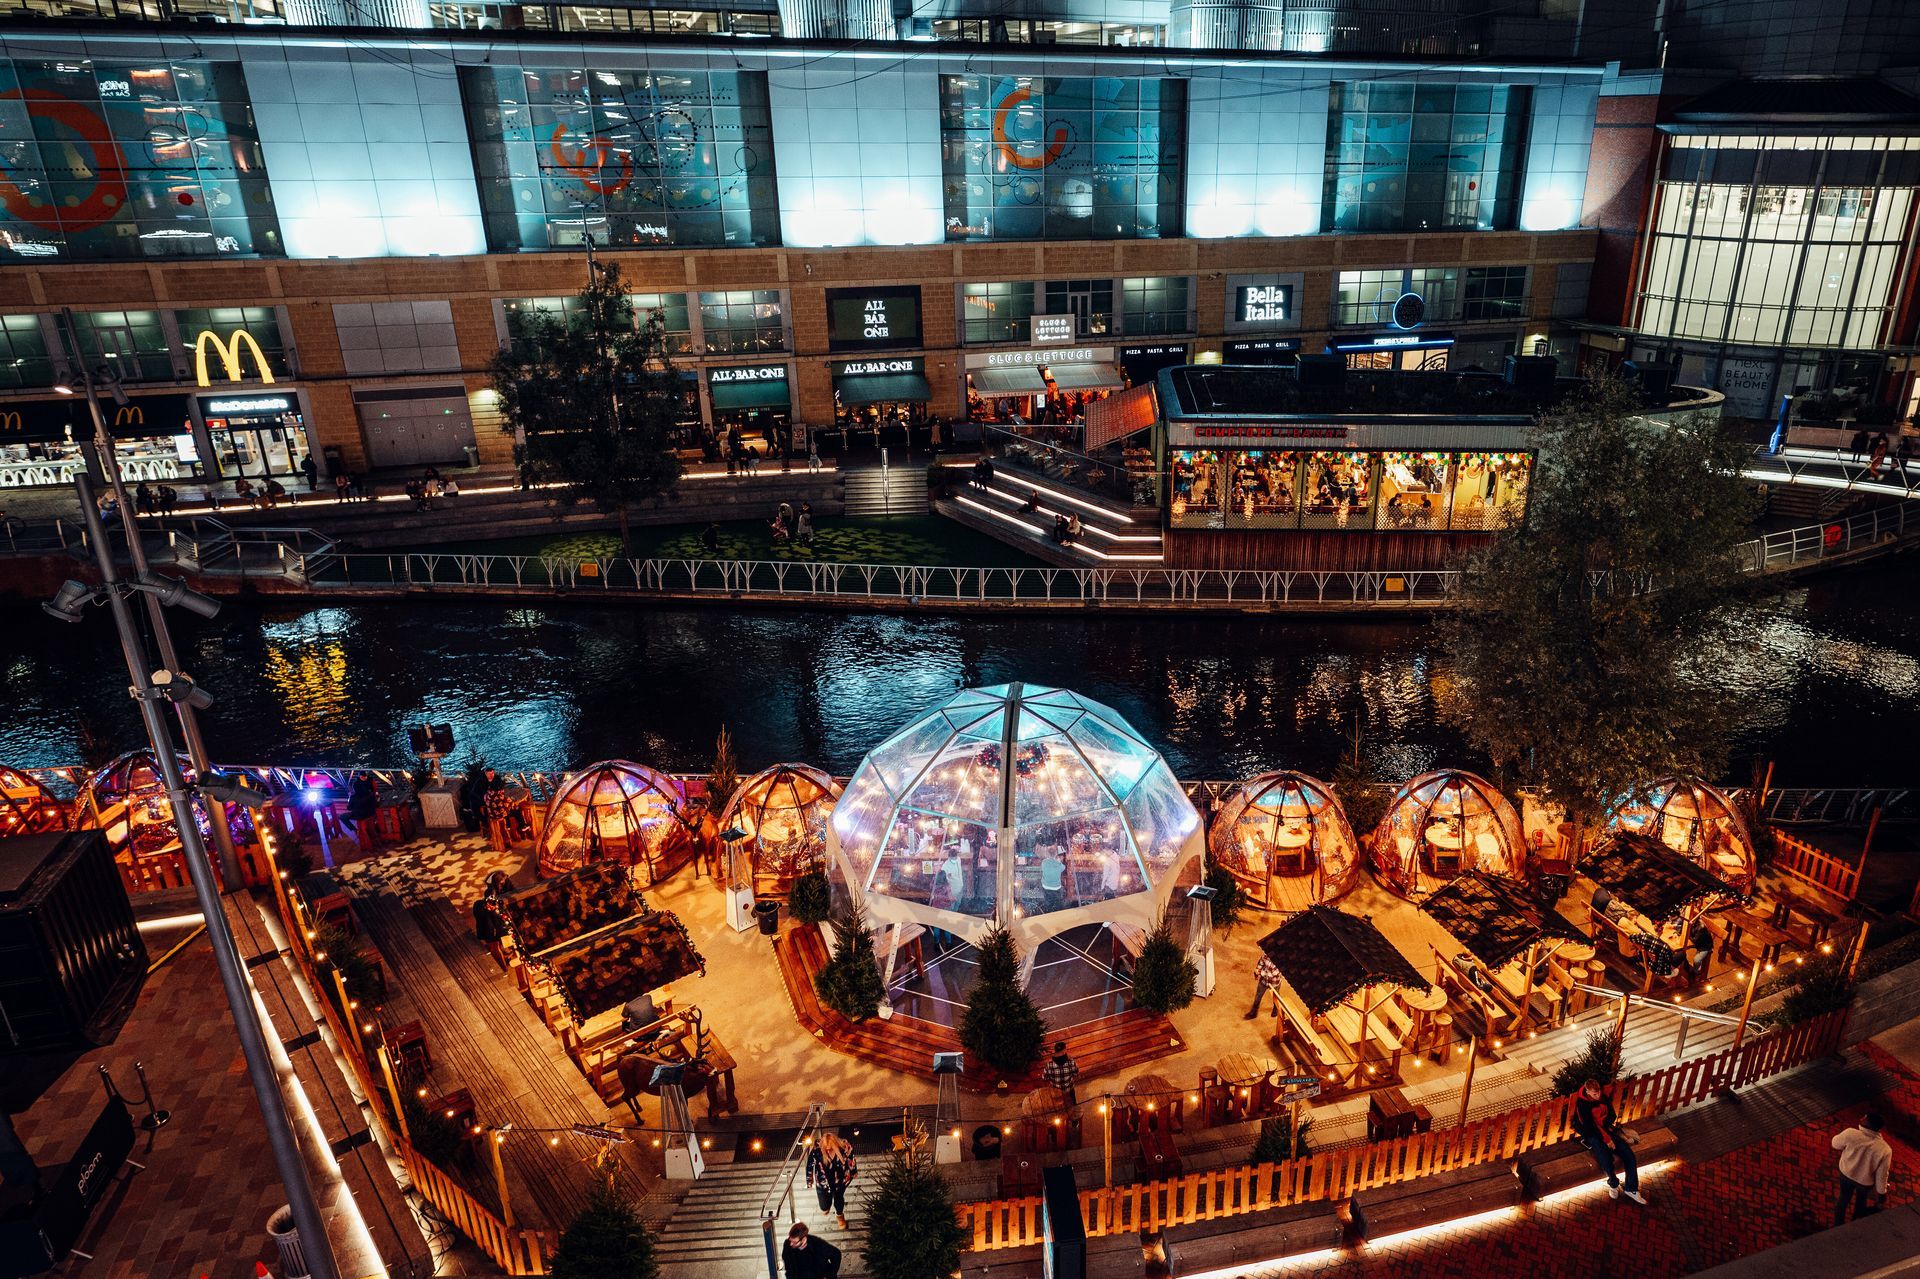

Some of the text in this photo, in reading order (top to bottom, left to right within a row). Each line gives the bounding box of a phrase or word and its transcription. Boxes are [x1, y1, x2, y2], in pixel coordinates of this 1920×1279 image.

[1246, 286, 1283, 304] Bella
[865, 301, 885, 311] ALL
[1245, 303, 1283, 321] Italia
[864, 313, 886, 324] BAR
[864, 327, 889, 338] ONE
[988, 350, 1093, 364] SLUG & LETTUCE
[1725, 369, 1772, 380] BEAUTY
[1724, 379, 1768, 390] & HOME
[1195, 427, 1273, 438] COMPTOIR
